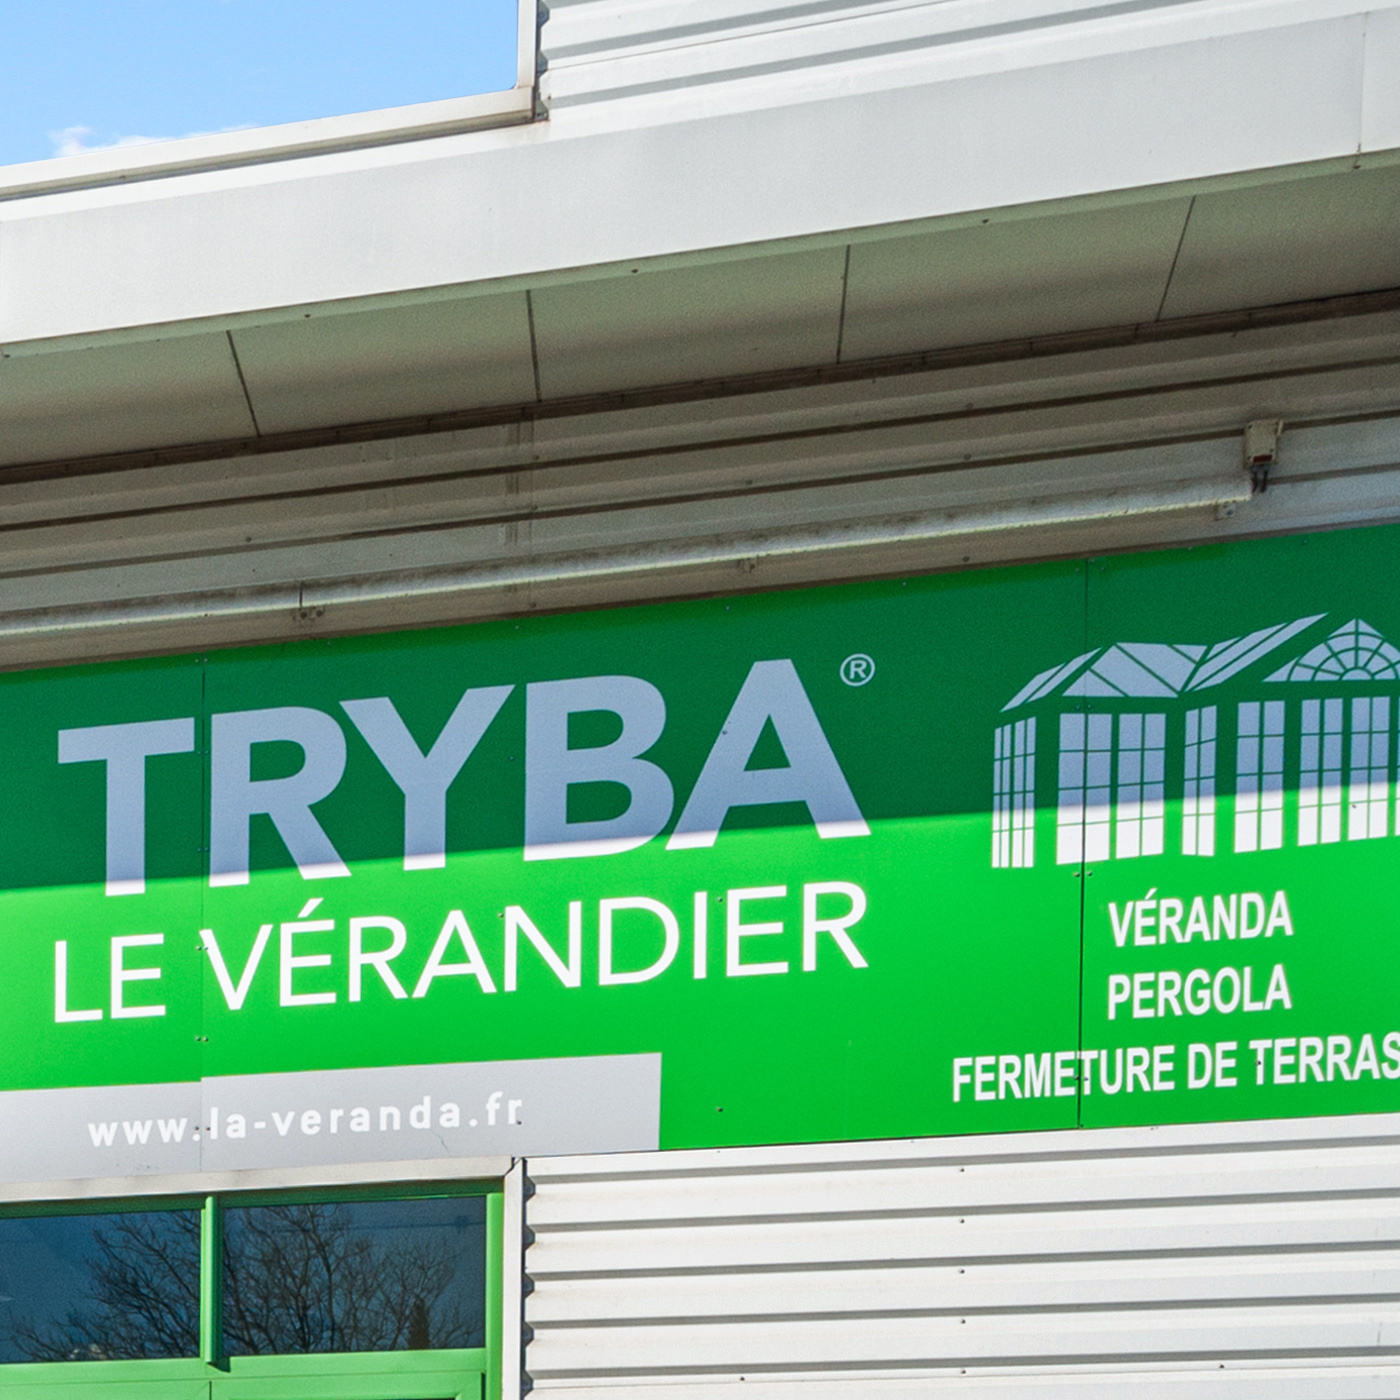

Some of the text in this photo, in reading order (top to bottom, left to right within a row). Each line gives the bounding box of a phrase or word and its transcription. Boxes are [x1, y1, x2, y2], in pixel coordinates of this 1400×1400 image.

[57, 658, 872, 897] TRYBA
[1108, 887, 1294, 948] VÉRANDA
[54, 880, 870, 1024] LE VÉRANDIER
[1108, 964, 1292, 1021] PERGOLA
[953, 1045, 1175, 1103] FERMETURE
[1187, 1041, 1238, 1090] DE
[88, 1091, 523, 1148] www.la-veranda.fr
